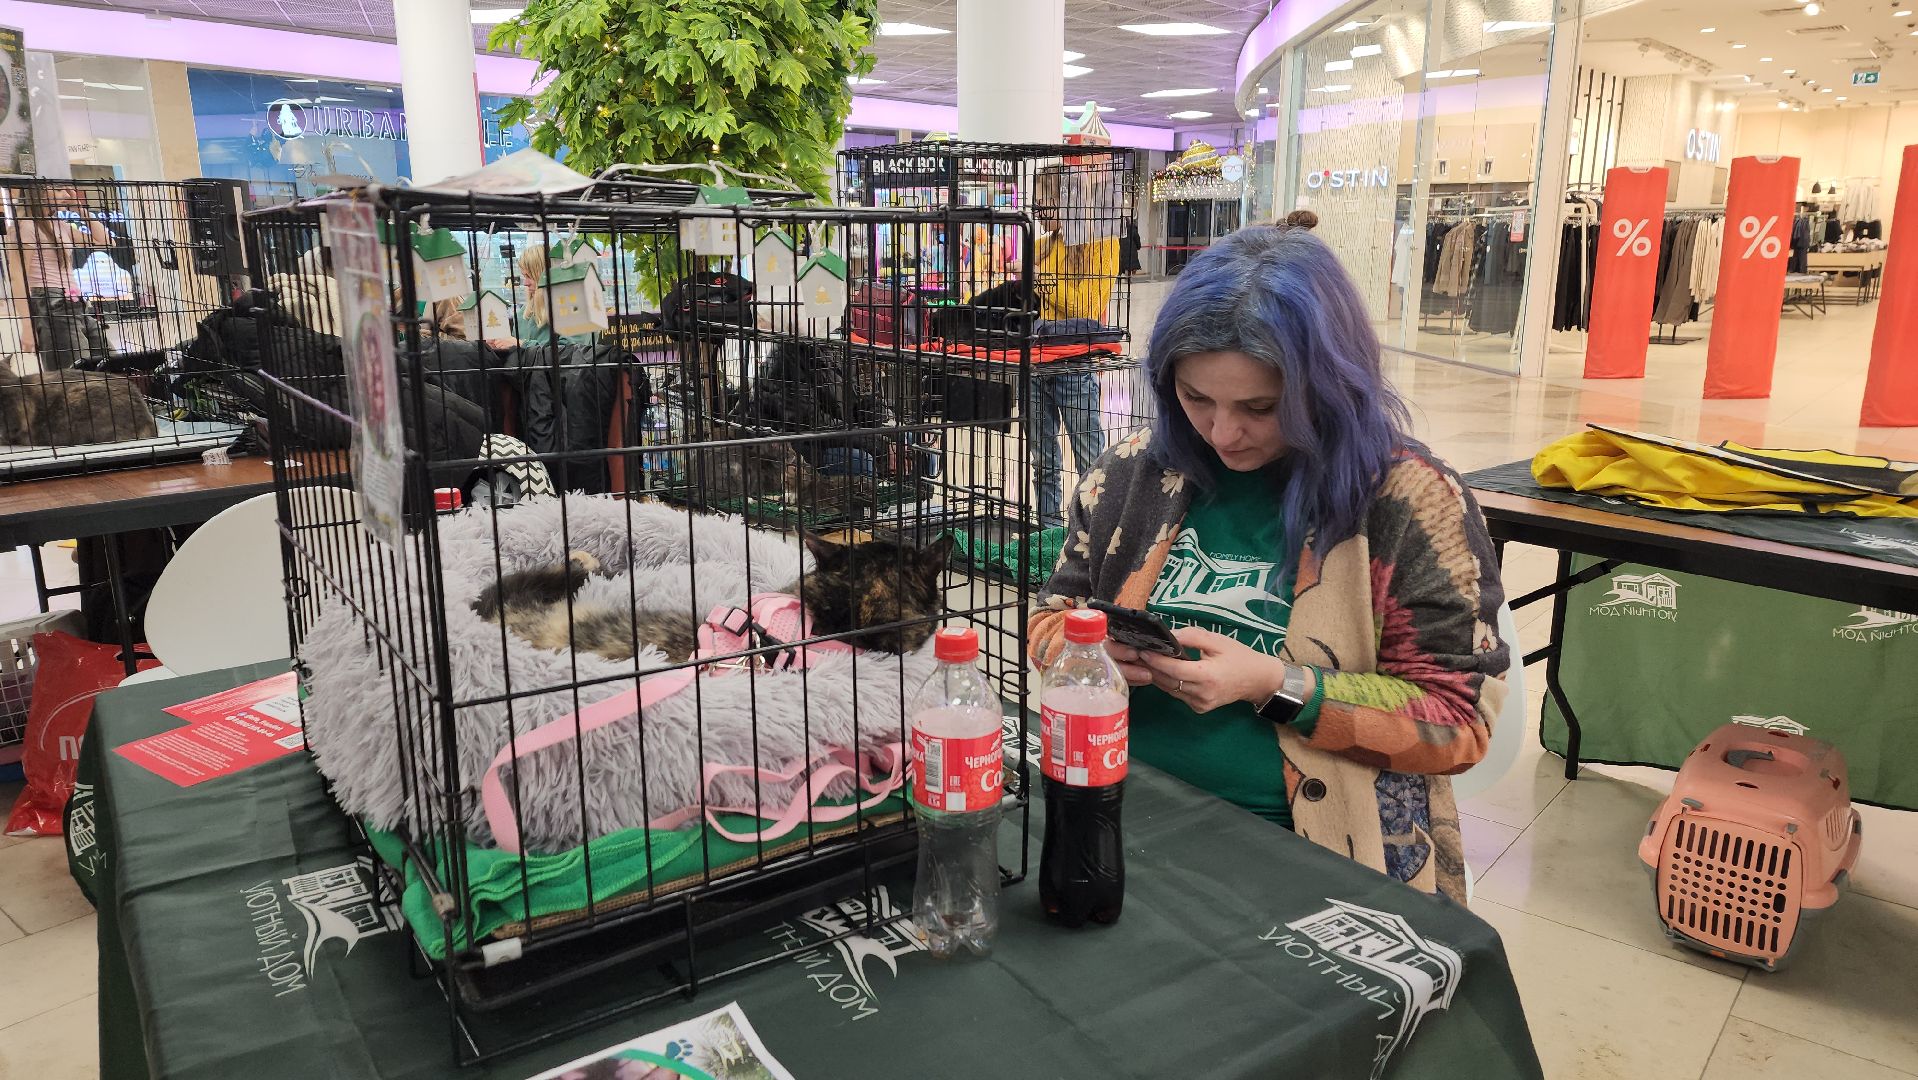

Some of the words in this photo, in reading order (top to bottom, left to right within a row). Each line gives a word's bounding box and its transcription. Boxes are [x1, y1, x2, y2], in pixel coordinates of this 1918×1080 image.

[872, 157, 915, 175] BLACK
[917, 155, 946, 173] BOX
[963, 158, 996, 174] BLACK
[996, 159, 1013, 176] BOX
[1613, 218, 1652, 257] %
[1739, 215, 1782, 260] %
[240, 880, 299, 953] УЮТНЫЙ
[257, 951, 307, 998] ДОМ
[1257, 926, 1401, 1021] УЮТНЫЙ
[806, 973, 879, 1021] ДОМ
